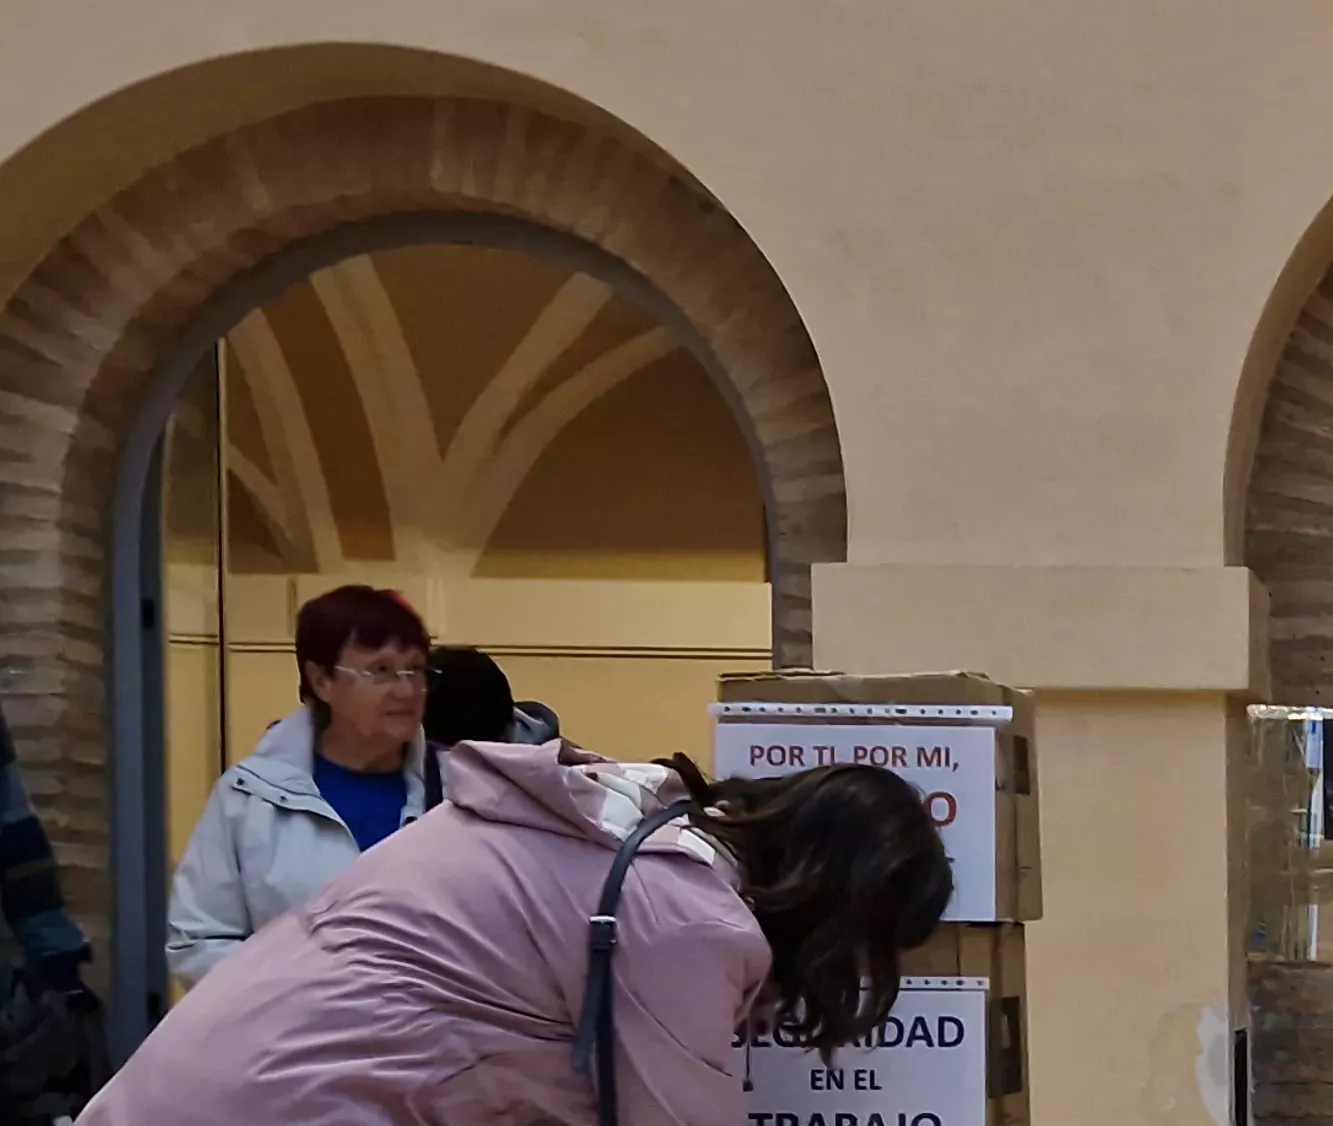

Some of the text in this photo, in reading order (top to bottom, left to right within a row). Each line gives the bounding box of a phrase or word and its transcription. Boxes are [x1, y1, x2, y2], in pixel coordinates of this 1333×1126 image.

[749, 745, 805, 767] POR
[853, 746, 908, 768] POR
[916, 747, 959, 772] MI,
[810, 1069, 882, 1091] EN EL
